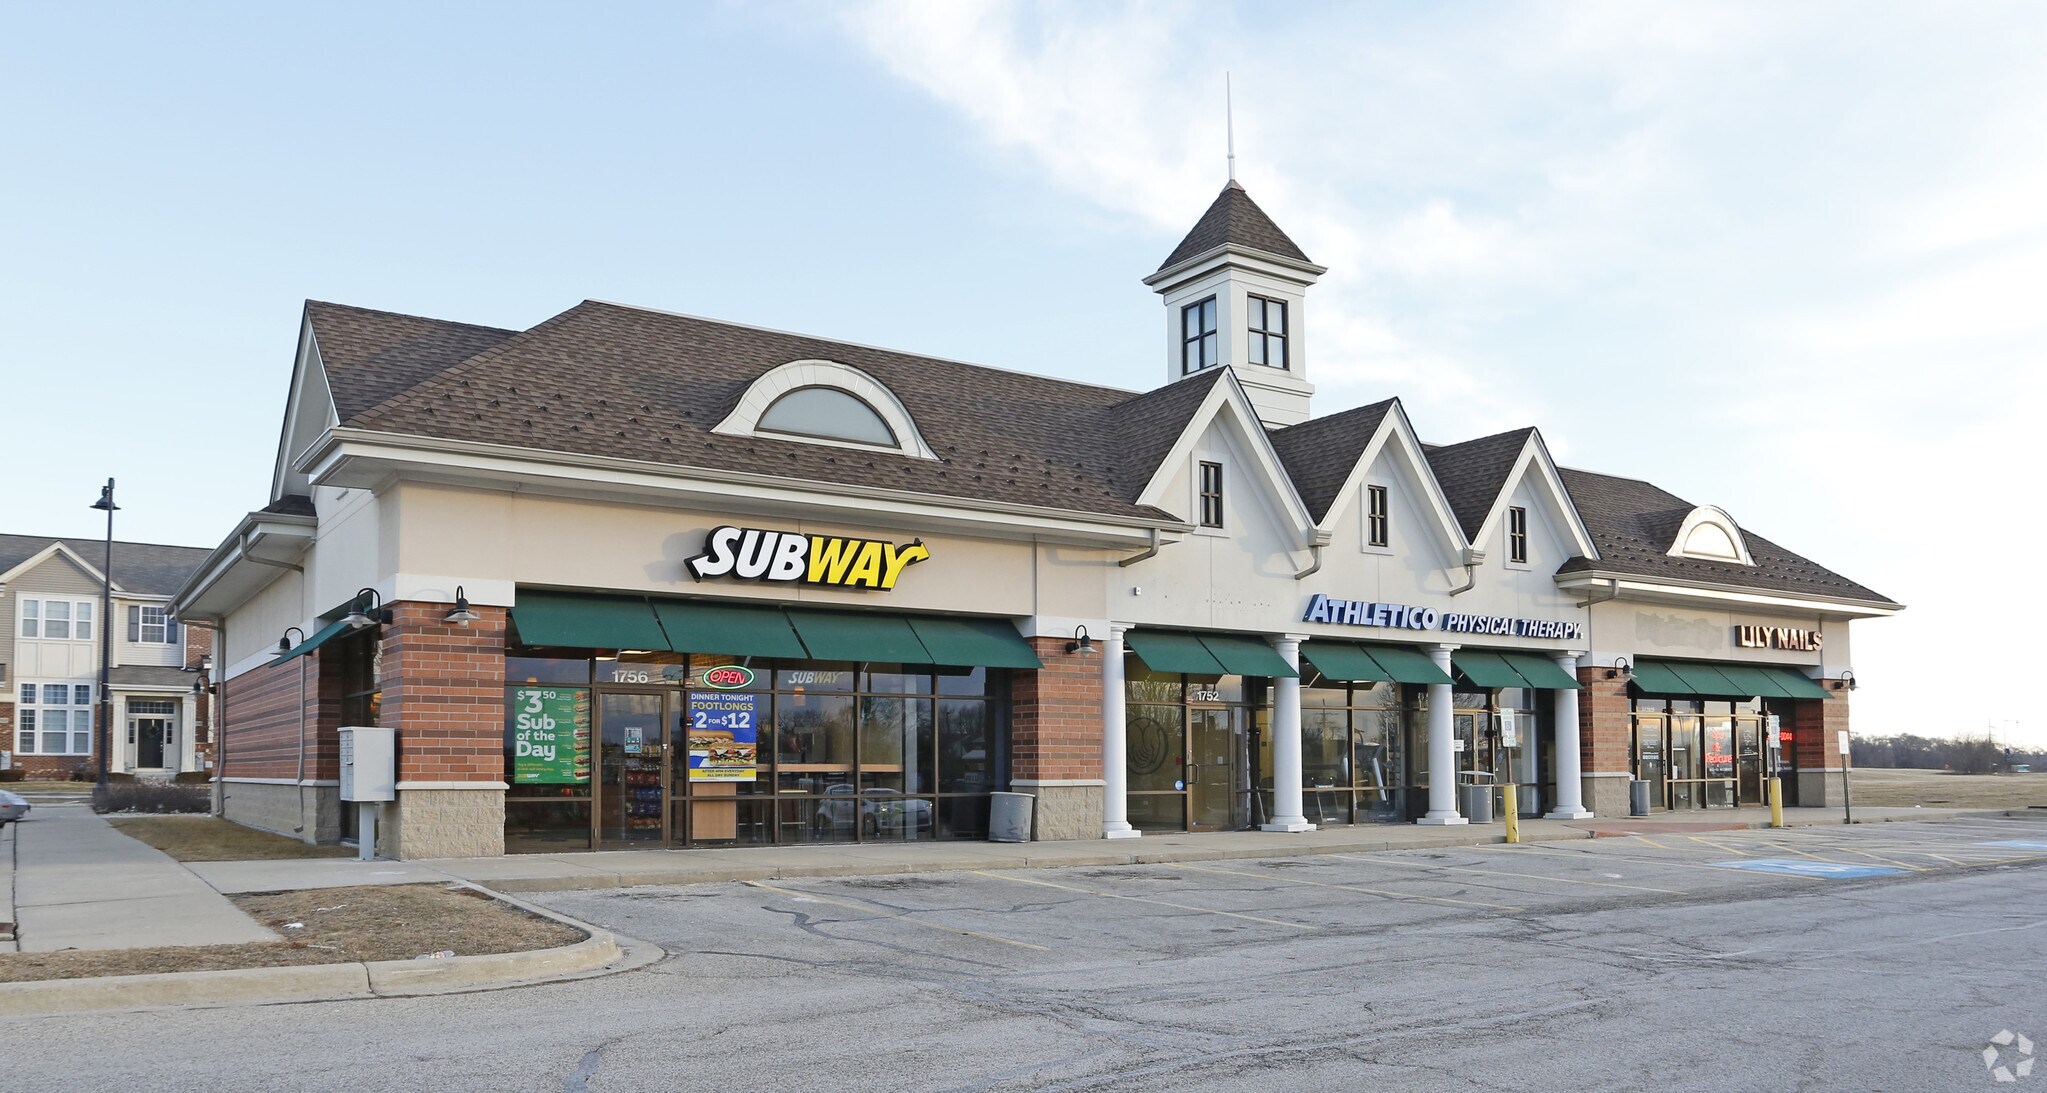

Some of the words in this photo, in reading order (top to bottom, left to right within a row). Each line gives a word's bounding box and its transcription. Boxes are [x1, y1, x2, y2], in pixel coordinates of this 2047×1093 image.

[685, 526, 930, 591] SUBWAY
[1305, 594, 1439, 630] ATHLETICO
[1446, 613, 1517, 635] PHYSICAL
[1520, 619, 1582, 639] THERAPY
[1740, 625, 1774, 648] LILY
[1776, 628, 1823, 651] NAILS
[611, 669, 649, 684] 1756
[709, 670, 746, 684] OPEN
[788, 671, 842, 684] SUBWAY
[691, 693, 720, 701] DINNER
[1197, 690, 1220, 702] 1752
[691, 701, 754, 711] FOOTLONGS
[517, 713, 556, 730] Sub
[695, 711, 707, 729] 2
[721, 712, 750, 729] $12
[516, 730, 531, 741] of
[533, 730, 556, 741] the
[516, 740, 556, 761] Day
